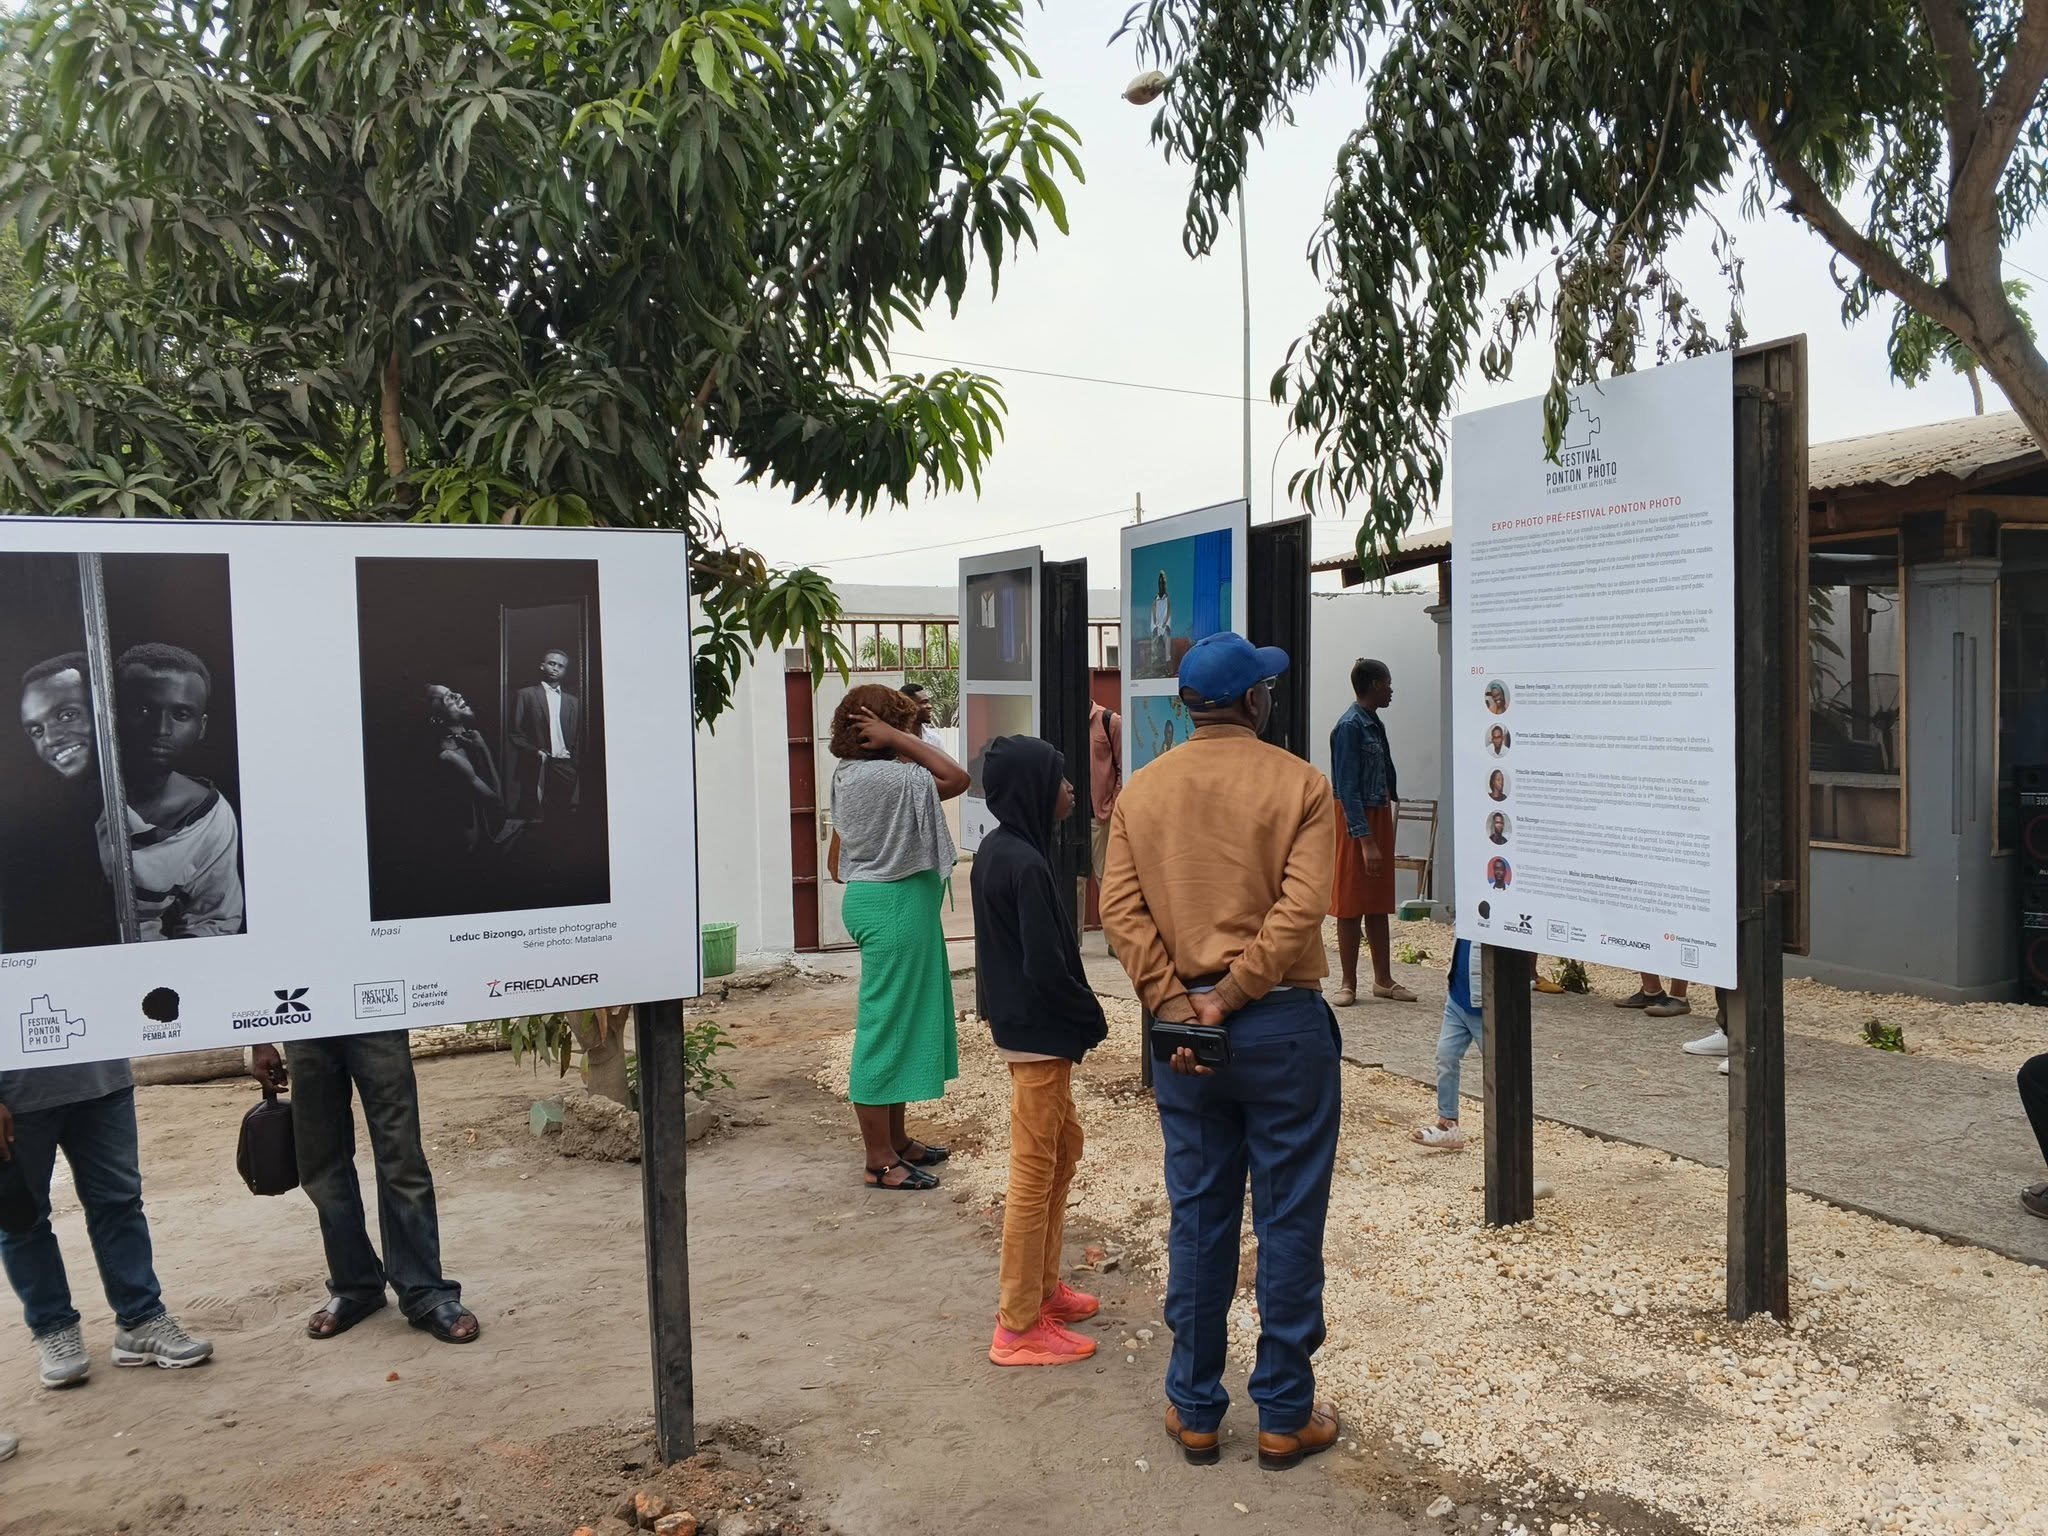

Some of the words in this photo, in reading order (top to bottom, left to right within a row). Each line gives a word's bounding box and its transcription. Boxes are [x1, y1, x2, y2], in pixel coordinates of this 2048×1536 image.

[1560, 448, 1601, 467] FESTIVAL
[1546, 468, 1581, 486] PONTON
[1588, 462, 1617, 479] PHOTO
[1491, 520, 1513, 532] EXPO
[1515, 516, 1544, 528] PHOTO
[1546, 508, 1606, 523] PRÉ-FESTIVAL
[1608, 501, 1646, 515] PONTON
[1649, 495, 1682, 509] PHOTO
[1471, 665, 1485, 676] BIO
[370, 925, 401, 938] Mpasi
[449, 932, 481, 943] Leduc
[483, 929, 527, 941] Bizongo,
[528, 924, 557, 936] artiste
[559, 920, 617, 934] photographe
[523, 939, 545, 949] Série
[546, 937, 573, 948] photo:
[575, 933, 613, 944] Matalana
[1607, 936, 1651, 950] FRIEDLANDER
[1, 956, 37, 969] Elongi
[411, 982, 439, 991] Liberté
[504, 973, 599, 993] FRIEDLANDER
[361, 988, 394, 997] INSTITUT
[412, 990, 448, 1000] Créativité
[362, 994, 399, 1005] FRANÇAIS
[412, 999, 445, 1008] Diversité
[231, 1008, 270, 1019] FABRIQUE
[28, 1016, 60, 1027] FESTIVAL
[232, 1012, 312, 1030] DIKOUKOU
[28, 1025, 60, 1036] PONTON
[142, 1022, 182, 1032] ASSOCIATION
[29, 1035, 61, 1045] PHOTO
[142, 1031, 167, 1041] PEMBA
[167, 1030, 182, 1039] ART
